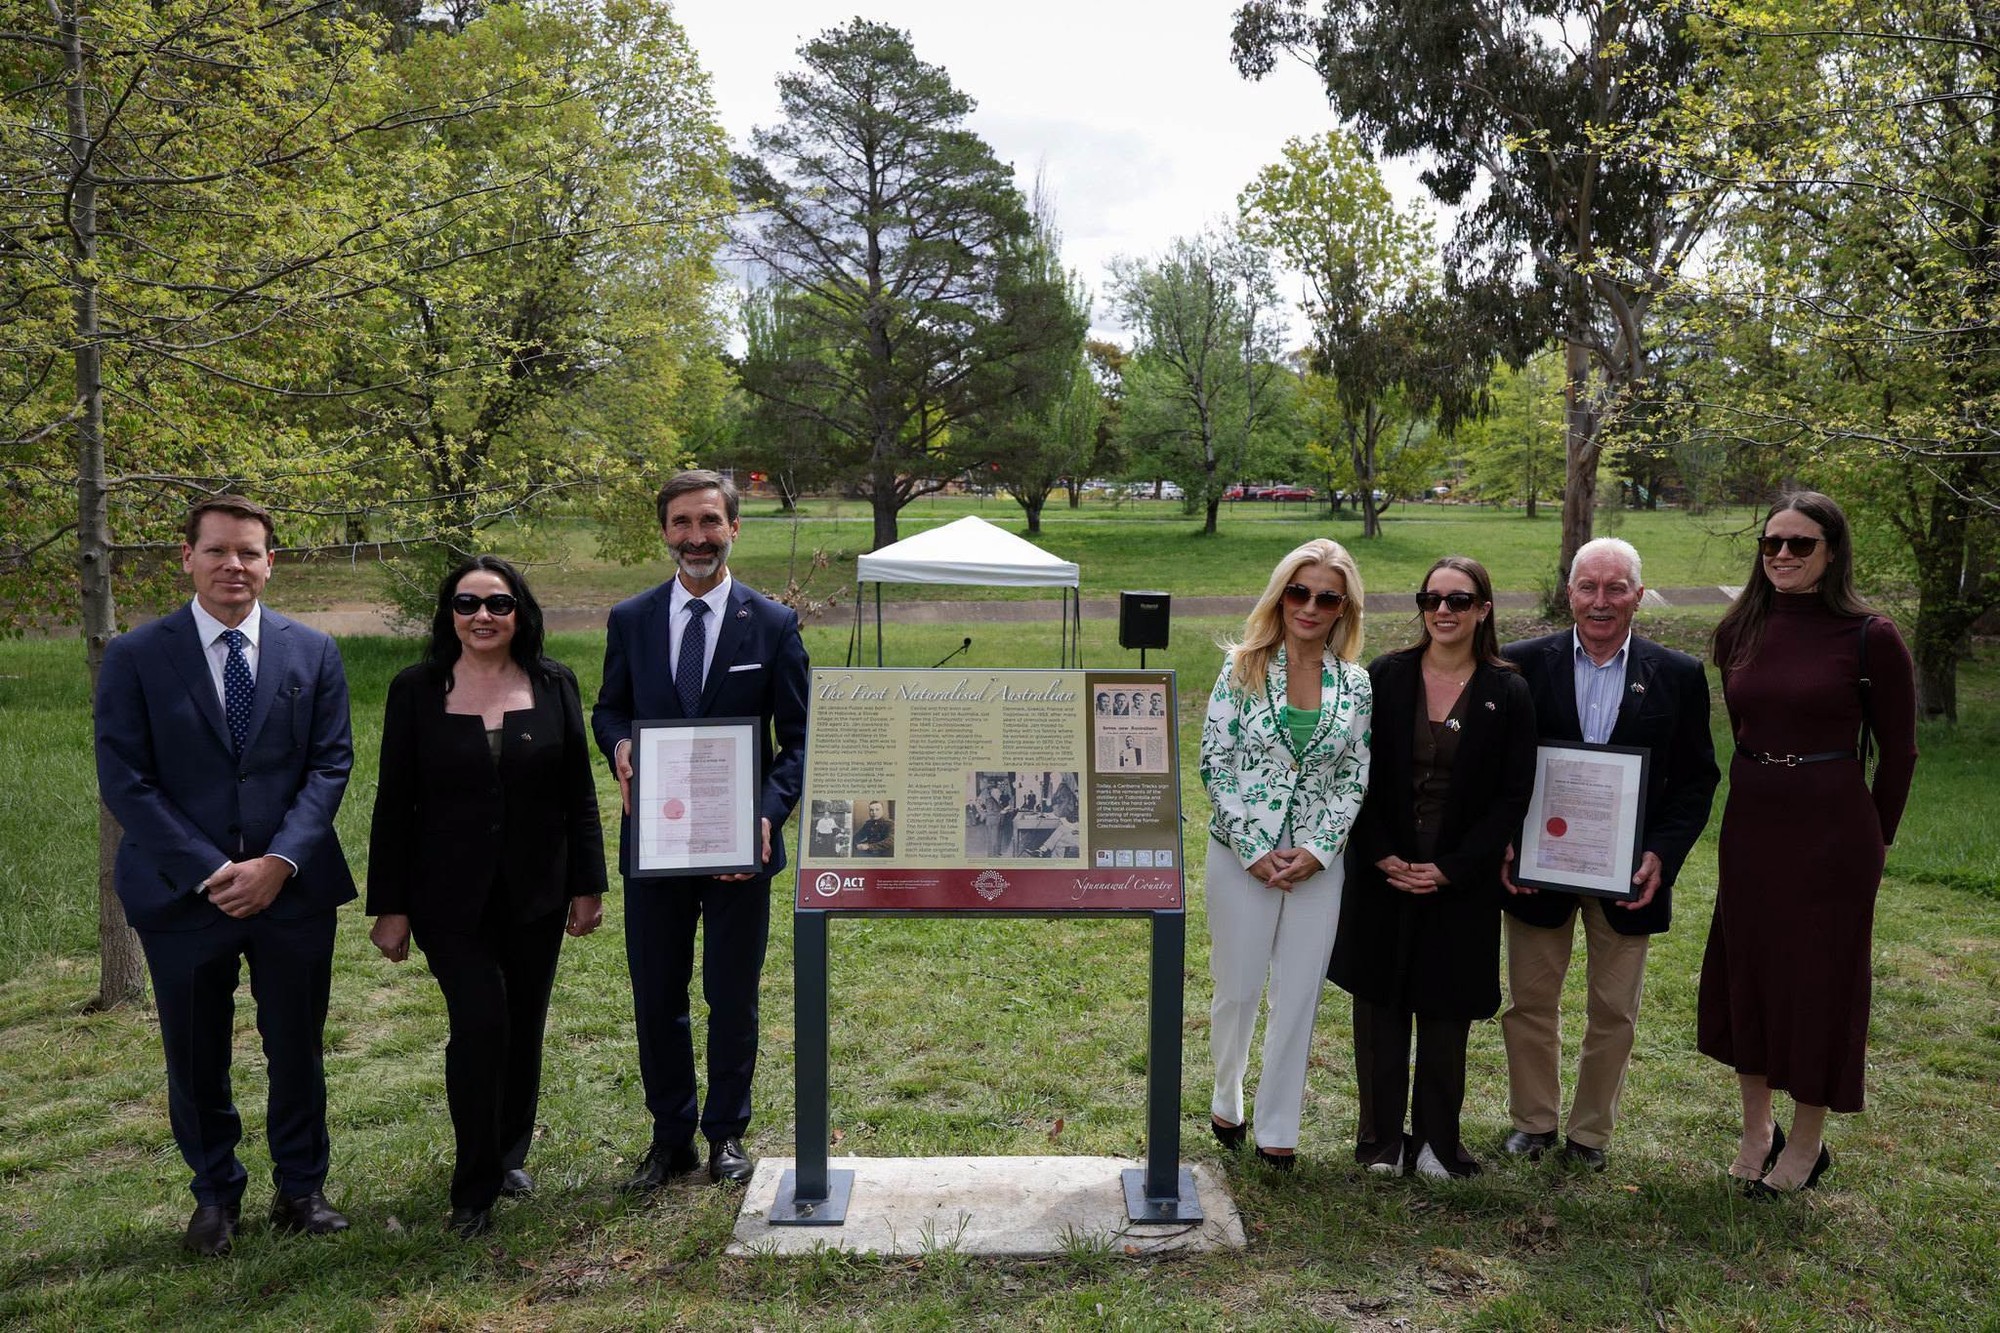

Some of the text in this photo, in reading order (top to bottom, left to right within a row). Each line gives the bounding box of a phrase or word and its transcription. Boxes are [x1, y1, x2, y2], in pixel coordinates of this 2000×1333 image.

[817, 675, 1076, 702] The First Naturalised Australian
[844, 878, 865, 887] ACT
[1072, 874, 1173, 900] Ngunnawal Country
